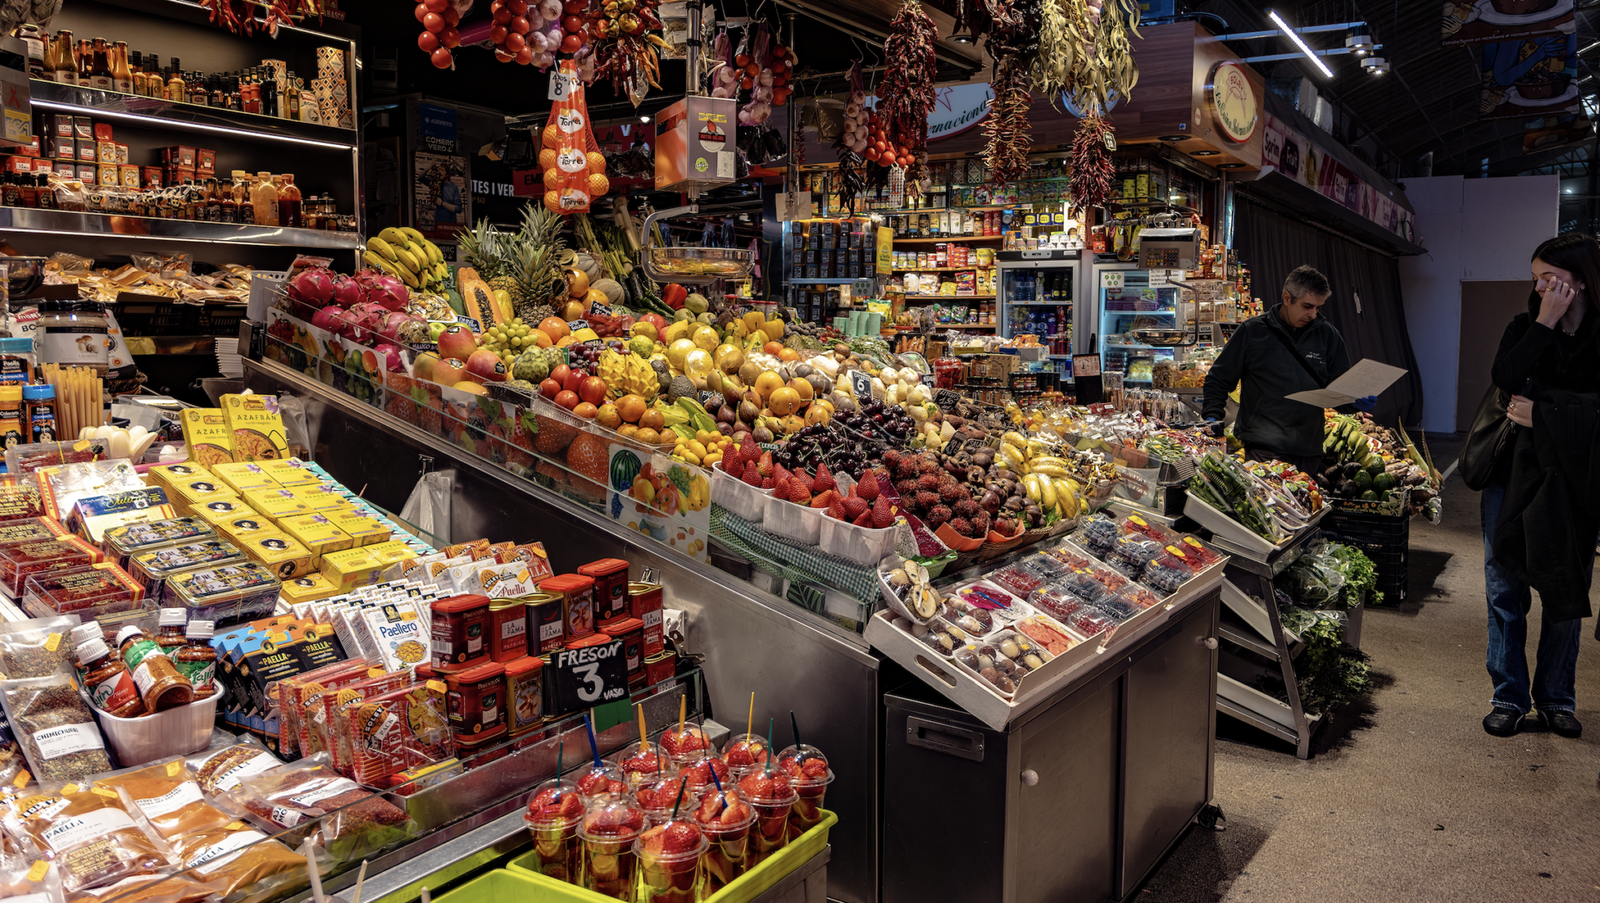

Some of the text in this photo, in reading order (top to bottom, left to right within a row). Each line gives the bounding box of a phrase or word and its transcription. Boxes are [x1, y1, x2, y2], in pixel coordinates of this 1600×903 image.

[554, 83, 563, 95] 8
[927, 90, 992, 134] ernacional
[560, 117, 582, 127] Torres
[1264, 133, 1298, 169] Sprim Fruit
[562, 156, 584, 166] Torres
[491, 181, 496, 195] I
[563, 197, 585, 207] Torres
[857, 379, 865, 391] 6
[237, 412, 277, 422] AZAFRÁN
[197, 429, 224, 438] AZAFR
[529, 564, 549, 578] LLA
[484, 574, 500, 590] SOLEY
[379, 622, 418, 638] Paellero
[507, 622, 514, 630] LA
[507, 626, 524, 636] FAMA
[545, 629, 562, 638] FAMA
[305, 641, 329, 653] PAELLA
[503, 640, 525, 650] PAPRIKA
[541, 642, 562, 651] PAPRIKA
[262, 653, 288, 666] PAELLA
[558, 641, 623, 669] FRESON
[572, 661, 604, 702] 3
[305, 693, 323, 706] SOL
[363, 706, 385, 733] SOLEY
[379, 718, 394, 737] PACK
[387, 702, 404, 768] PAELA
[46, 820, 84, 839] PAELLA
